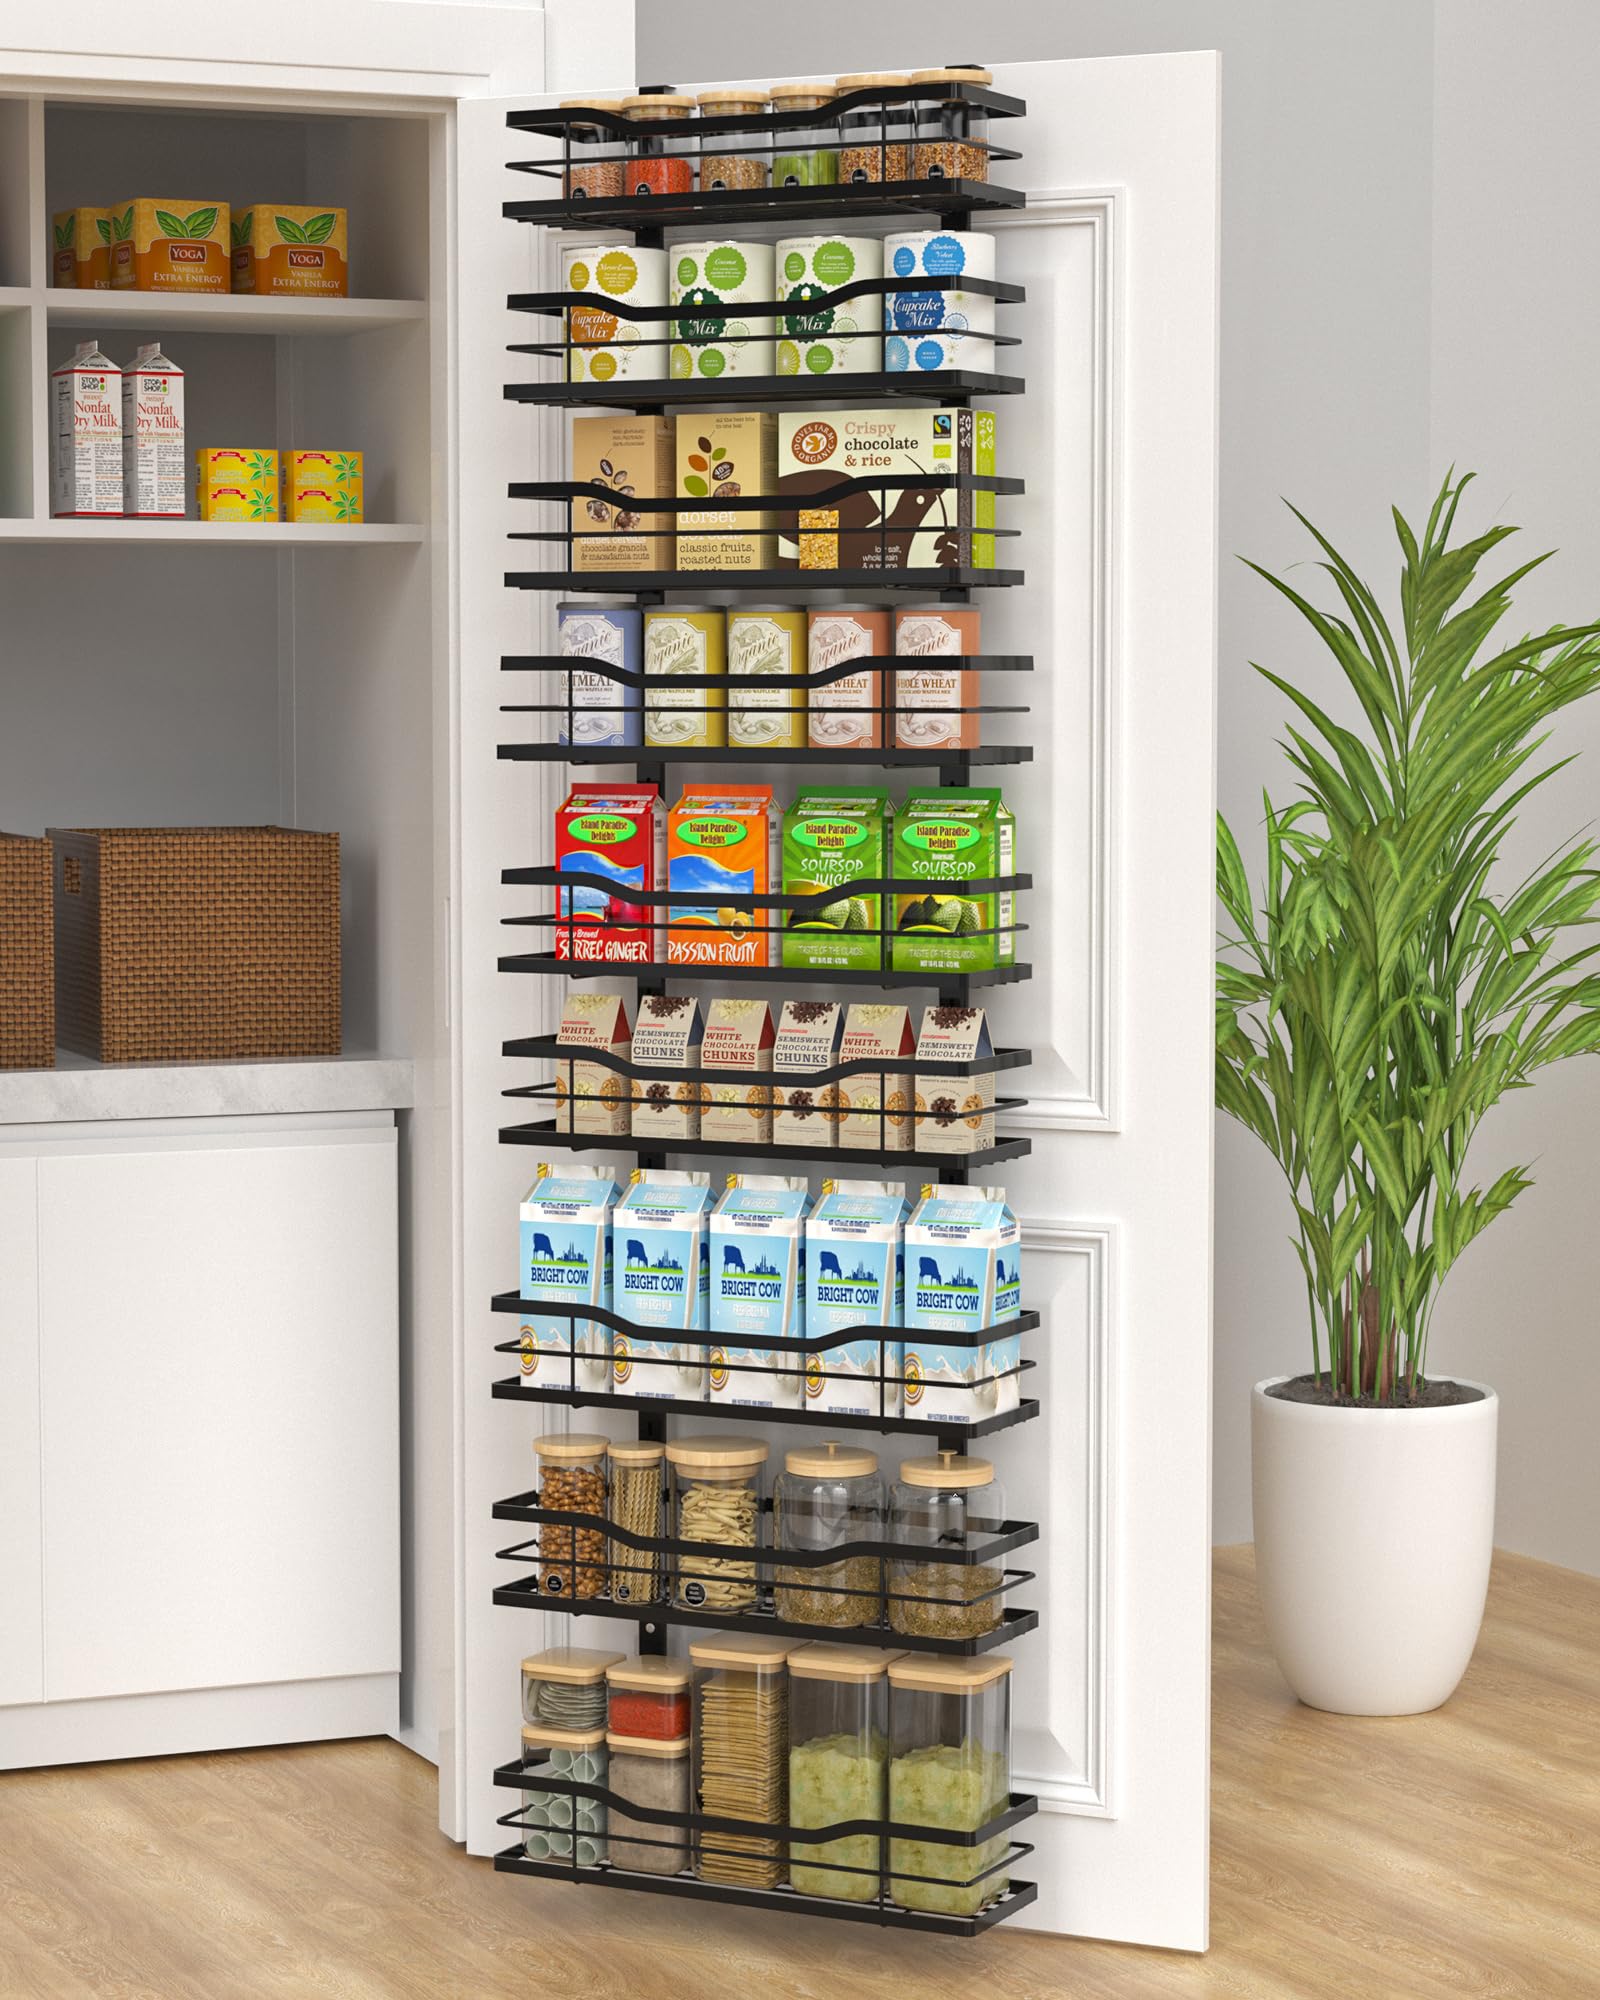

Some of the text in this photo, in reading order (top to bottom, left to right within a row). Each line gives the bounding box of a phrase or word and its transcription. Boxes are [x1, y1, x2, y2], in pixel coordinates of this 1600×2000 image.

[172, 248, 203, 259] YOGA
[291, 253, 321, 264] YOGA
[153, 272, 223, 284] EXTRA ENERGY
[272, 277, 340, 289] EXTRA ENERGY
[895, 297, 941, 315] Cupcake
[571, 311, 613, 328] Cupcake
[796, 316, 825, 331] Mix
[905, 311, 935, 328] Mix
[582, 325, 609, 339] Mix
[688, 320, 717, 336] Mix
[75, 400, 111, 414] Nonfat
[138, 402, 172, 415] Nonfat
[93, 414, 118, 428] Milk
[155, 416, 180, 429] Milk
[844, 422, 896, 437] Crispy
[794, 424, 835, 463] DOVES FARM ORGANIC
[844, 437, 919, 451] chocolate
[844, 453, 892, 467] & rice
[679, 511, 737, 524] dorset
[680, 543, 718, 553] classic
[680, 554, 752, 565] roasted nuts
[833, 679, 868, 688] WHEAT
[921, 679, 957, 688] WHEAT
[580, 820, 627, 831] Island Paradise
[689, 822, 738, 833] Island Paradise
[805, 823, 858, 835] Island Paradise
[916, 825, 970, 837] Island Paradise
[591, 831, 616, 842] Delights
[700, 834, 726, 845] Delights
[817, 835, 845, 847] Delights
[928, 837, 957, 850] Delights
[801, 858, 864, 873] SOURSOP
[911, 860, 977, 876] SOURSOP
[605, 940, 648, 962] GINGER
[667, 940, 759, 962] PASSION FRUITY
[561, 1026, 597, 1035] WHITE
[636, 1029, 687, 1038] SEMISWEET
[706, 1032, 742, 1041] WHITE
[558, 1035, 609, 1044] CHOCOLATE
[634, 1037, 685, 1046] CHOCOLATE
[703, 1041, 757, 1050] CHOCOLATE
[777, 1035, 830, 1045] SEMISWEET
[844, 1038, 881, 1047] WHITE
[633, 1046, 684, 1057] CHUNKS
[776, 1044, 829, 1053] CHOCOLATE
[841, 1047, 896, 1056] CHOCOLATE
[919, 1041, 975, 1051] SEMISWEET
[703, 1050, 755, 1061] CHUNKS
[775, 1052, 828, 1064] CHUNKS
[918, 1050, 973, 1059] CHOCOLATE
[531, 1267, 589, 1285] BRIGHT COW
[624, 1274, 684, 1292] BRIGHT COW
[721, 1280, 782, 1299] BRIGHT COW
[817, 1286, 879, 1305] BRIGHT COW
[916, 1292, 979, 1311] BRIGHT COW
